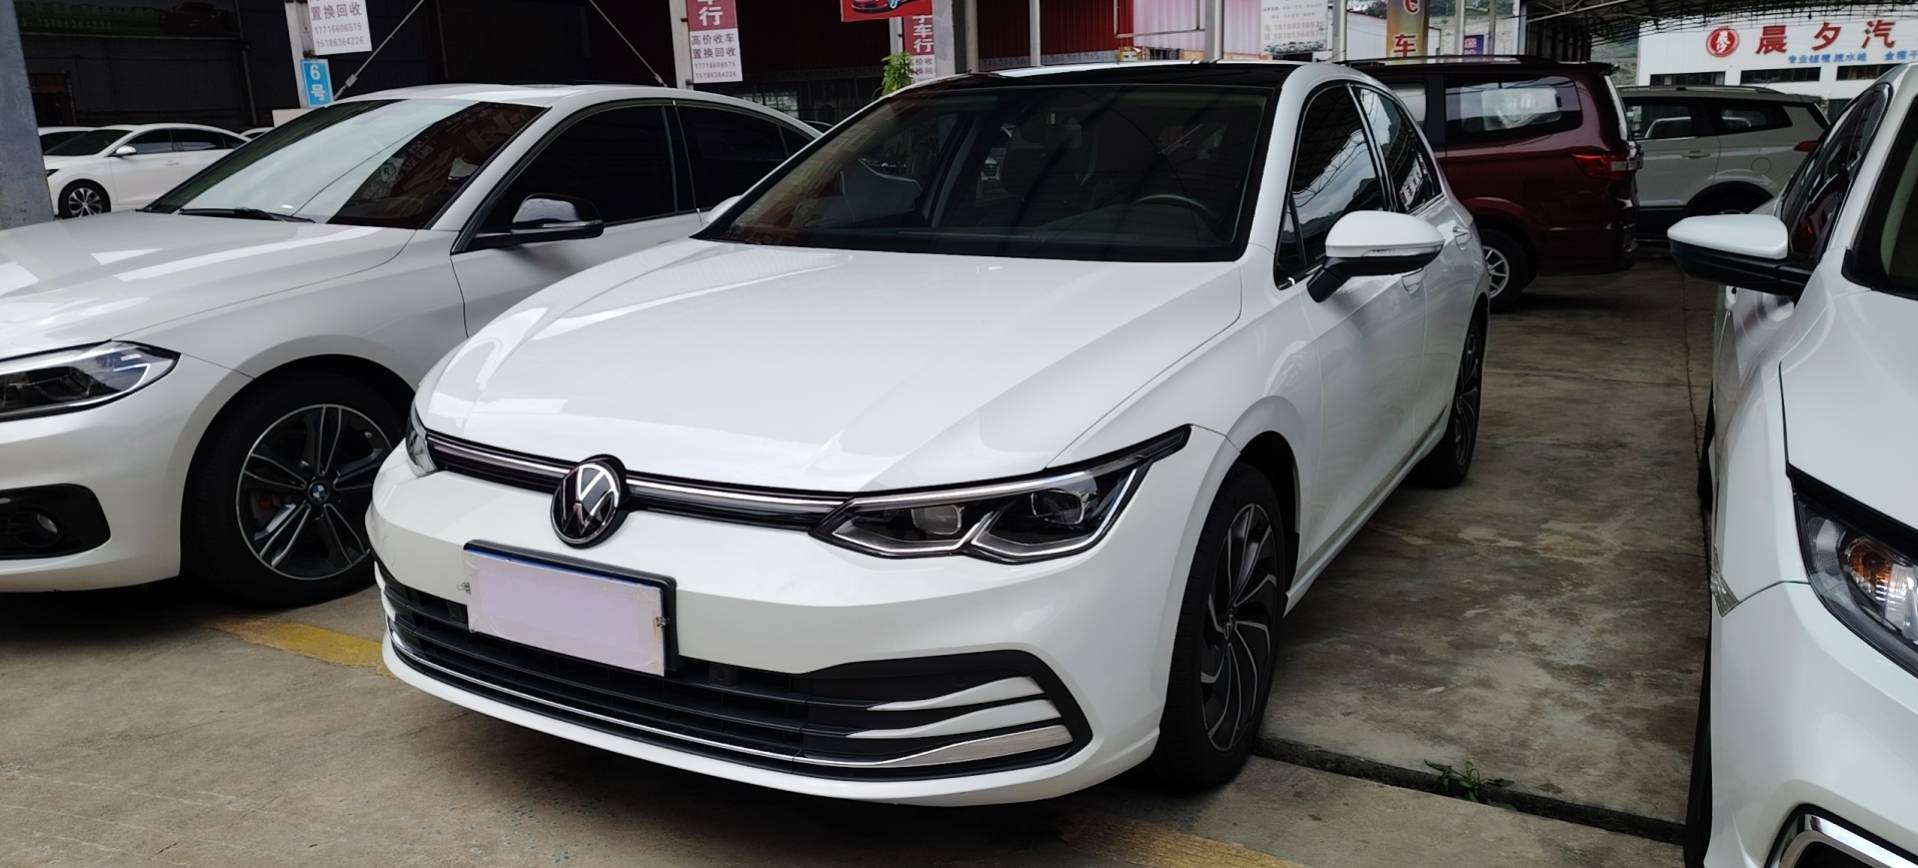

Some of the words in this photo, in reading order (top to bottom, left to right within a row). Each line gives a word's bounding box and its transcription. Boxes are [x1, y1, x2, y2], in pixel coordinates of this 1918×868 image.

[311, 1, 362, 21] 置换回收
[697, 0, 724, 27] 行
[691, 32, 735, 46] 高价收车
[1756, 19, 1897, 55] 晨夕汽
[692, 46, 737, 59] 置换回收
[309, 64, 326, 101] 6号
